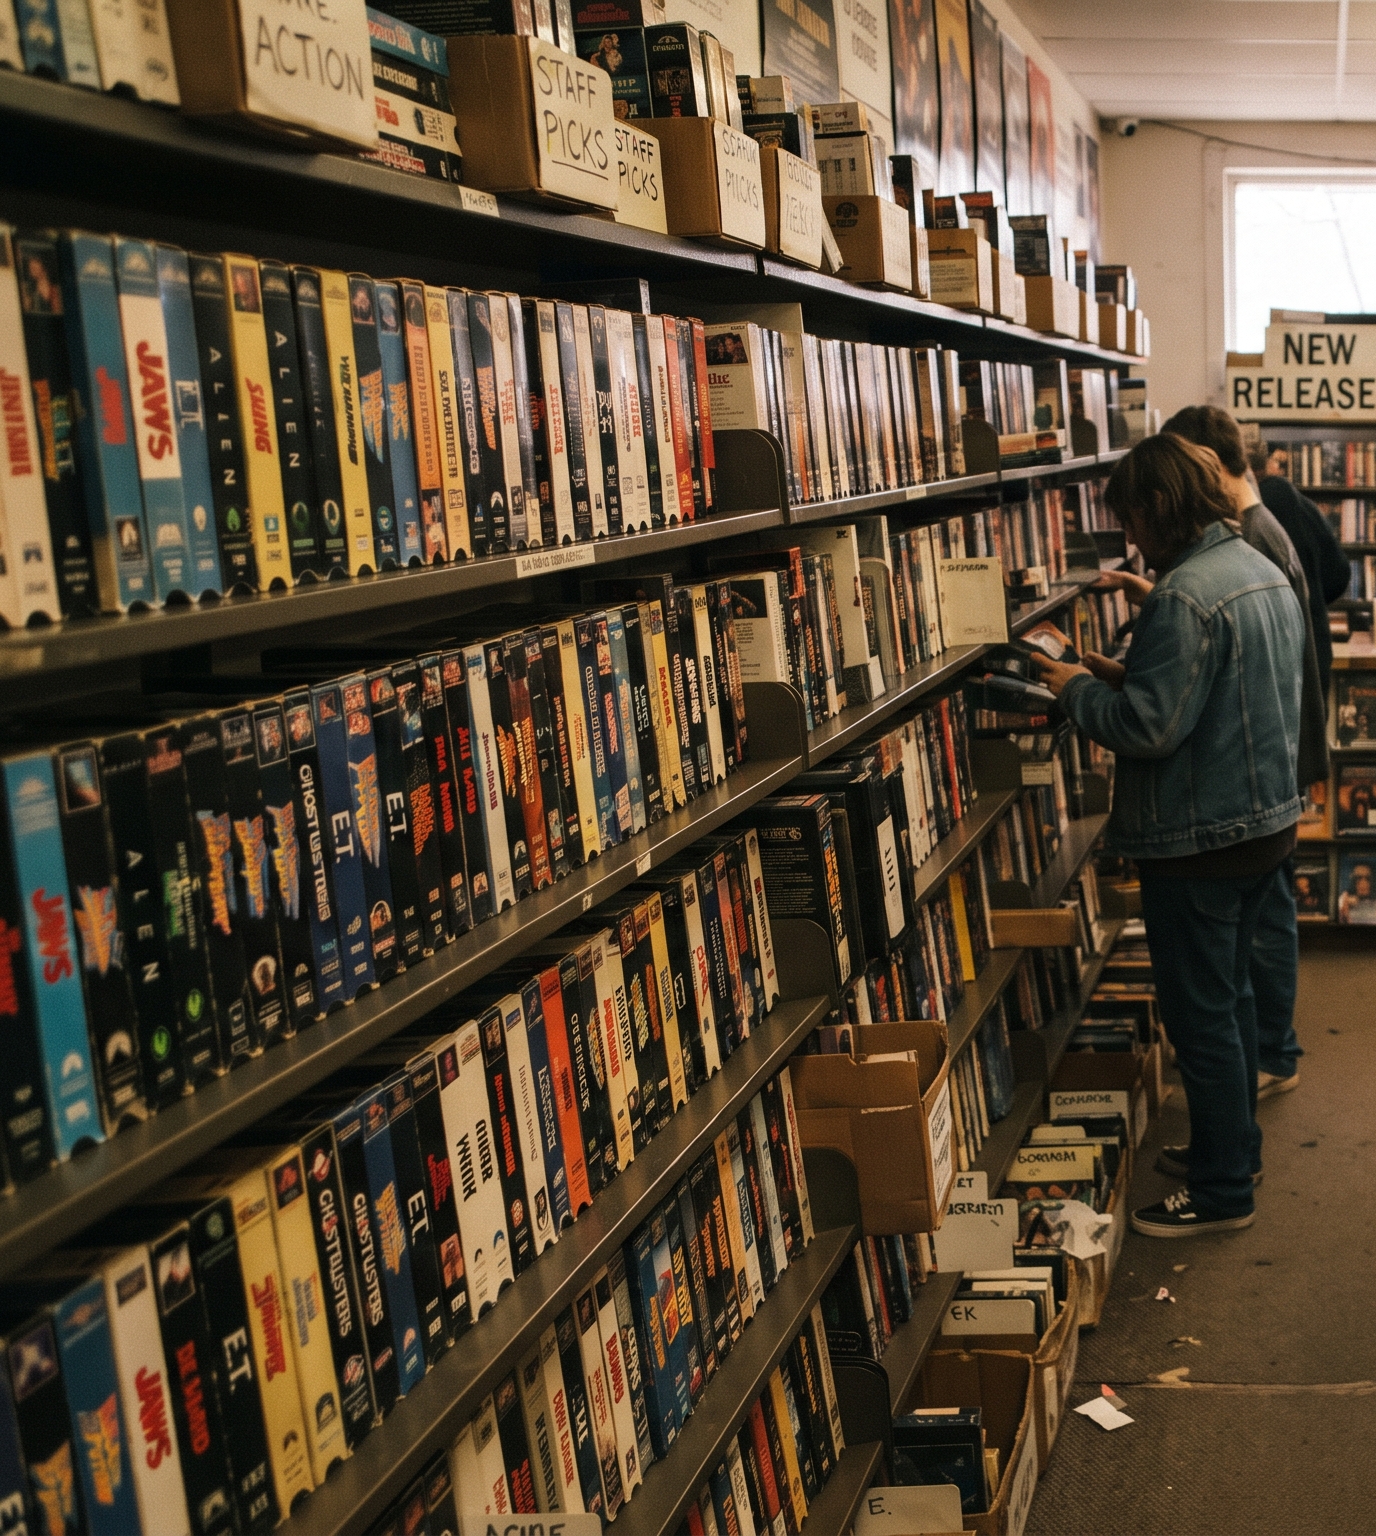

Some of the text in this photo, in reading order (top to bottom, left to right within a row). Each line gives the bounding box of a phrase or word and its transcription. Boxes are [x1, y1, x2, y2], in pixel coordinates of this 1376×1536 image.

[255, 16, 364, 101] ACTION
[536, 55, 597, 109] STAFF
[543, 110, 609, 170] PICKS
[614, 127, 654, 166] STAFF
[617, 160, 659, 202] PICKS
[1283, 332, 1357, 366] NEW
[136, 340, 174, 461] JAWS
[275, 330, 301, 469] ALIEN
[331, 809, 356, 864] E.T.
[386, 791, 407, 842] E.T.
[135, 1366, 172, 1470] JAWS
